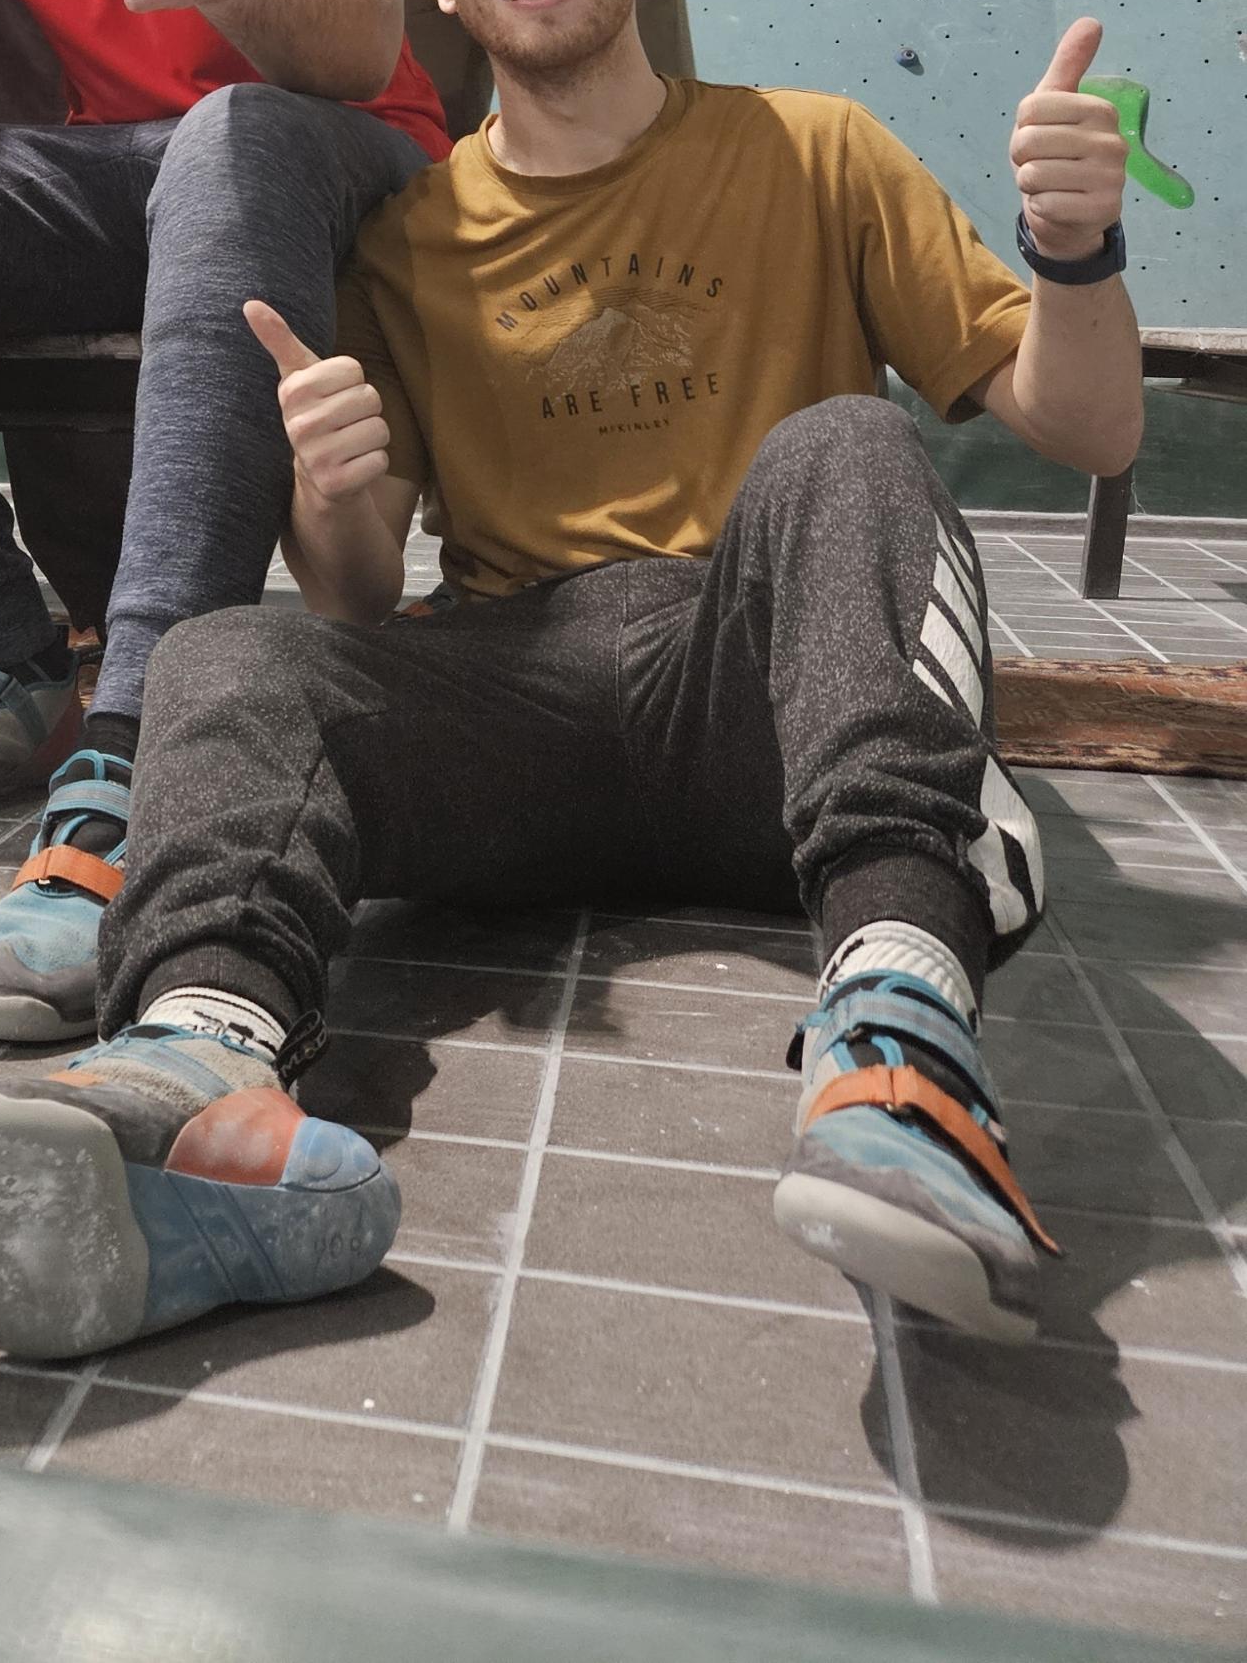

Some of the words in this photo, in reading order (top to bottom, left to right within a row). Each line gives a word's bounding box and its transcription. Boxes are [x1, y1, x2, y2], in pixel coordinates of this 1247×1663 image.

[496, 253, 723, 332] MOUNTAINS
[541, 390, 602, 419] ARE
[630, 372, 721, 408] FREE
